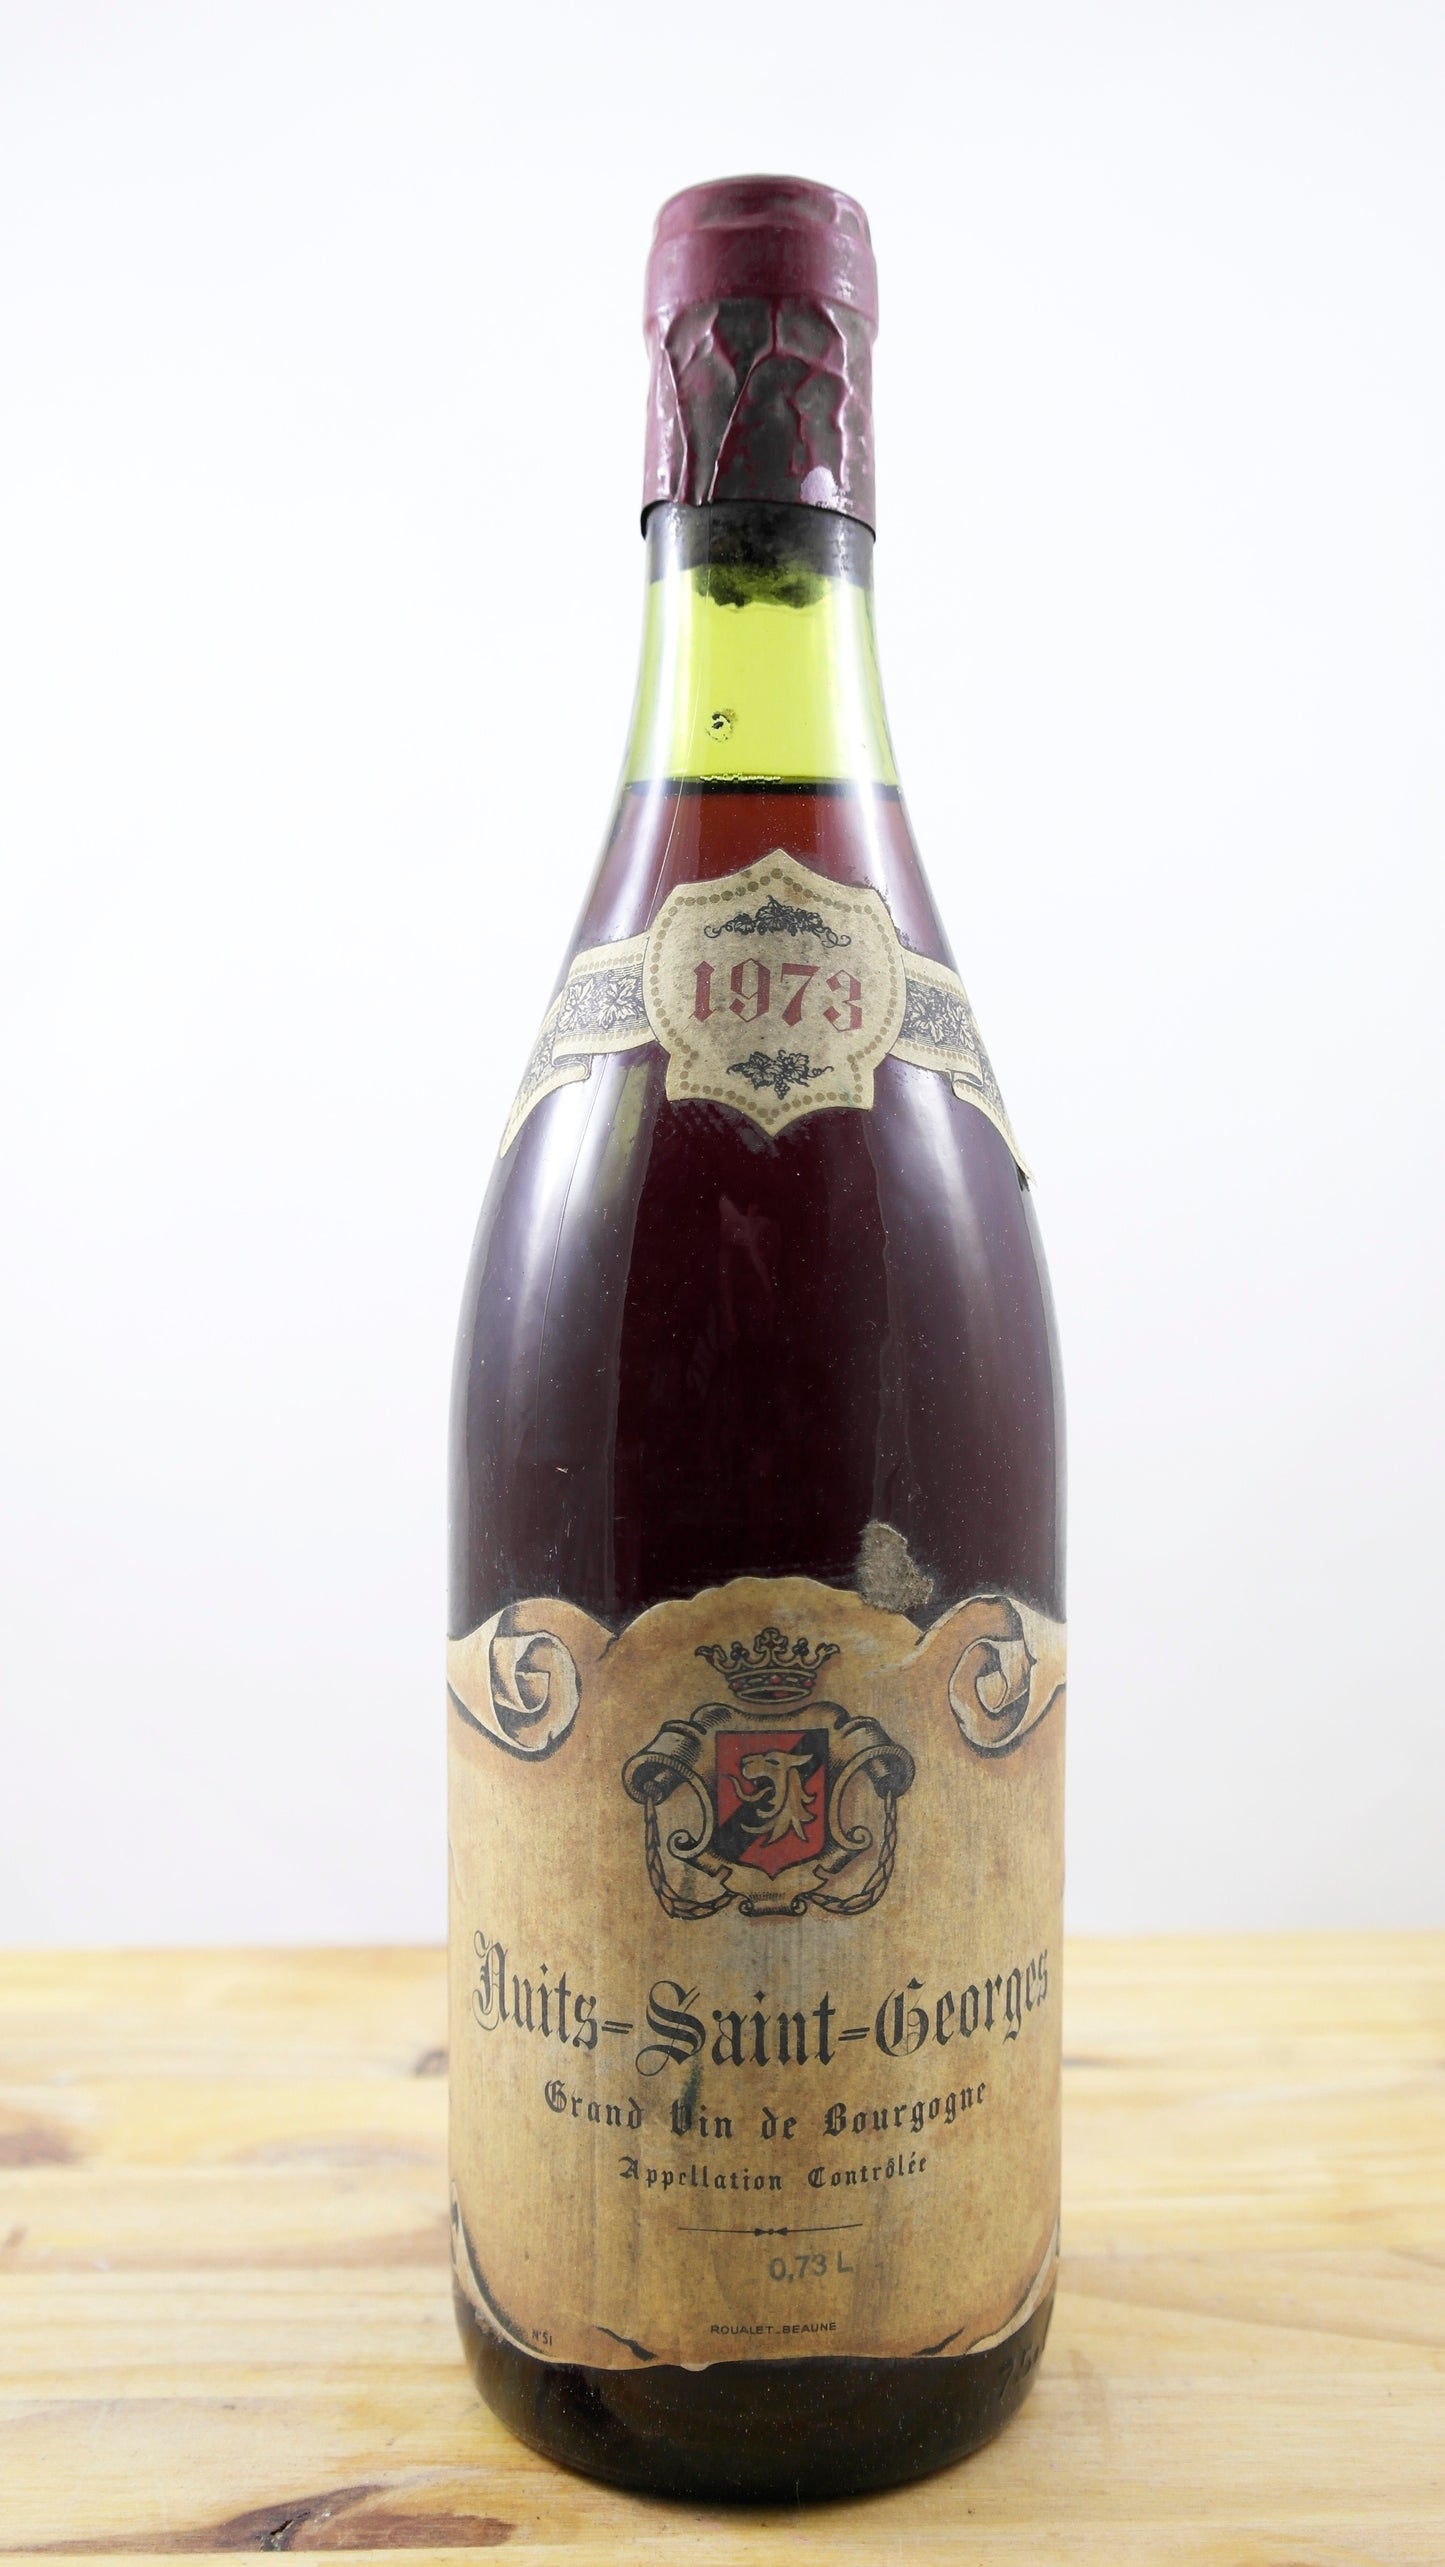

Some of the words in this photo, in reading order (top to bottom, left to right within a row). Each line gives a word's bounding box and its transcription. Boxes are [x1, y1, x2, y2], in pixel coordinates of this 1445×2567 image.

[688, 957, 862, 1033] 1973
[543, 2080, 643, 2130] Grand
[670, 2100, 733, 2138] Vin
[760, 2105, 797, 2140] de
[823, 2081, 987, 2137] Bourgogne
[618, 2155, 784, 2192] Appellation
[807, 2154, 928, 2190] Contrôlée
[769, 2253, 828, 2284] 0,73
[837, 2250, 854, 2273] L
